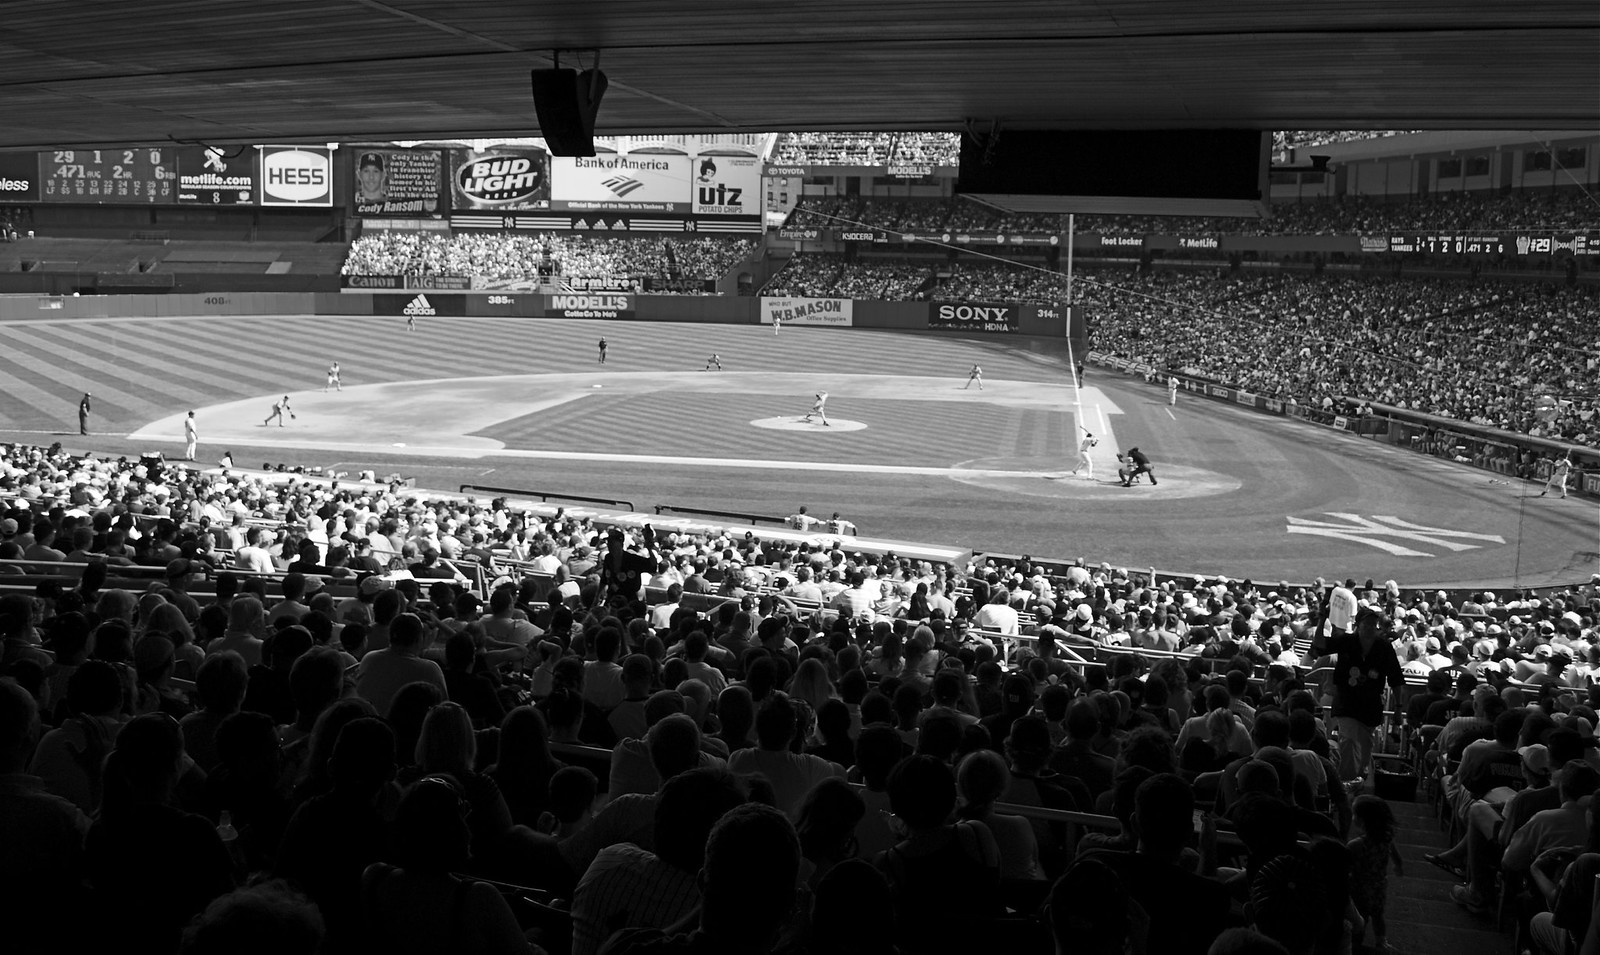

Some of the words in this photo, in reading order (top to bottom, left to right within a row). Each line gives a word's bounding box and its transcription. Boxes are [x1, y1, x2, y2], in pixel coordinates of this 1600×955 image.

[54, 150, 74, 163] 29
[94, 150, 102, 164] 1
[123, 150, 134, 164] 2
[150, 151, 160, 164] 0
[575, 156, 605, 168] Bank
[606, 157, 619, 168] of
[620, 158, 669, 170] America
[53, 164, 86, 178] .471
[112, 165, 122, 179] 2
[155, 166, 165, 180] 6
[472, 159, 530, 178] BUD
[888, 166, 932, 175] MODELL'S
[180, 174, 252, 185] metlife.com
[269, 168, 324, 185] HESS
[464, 172, 538, 192] LIGHT
[0, 178, 29, 191] less
[213, 192, 220, 204] 8
[842, 232, 873, 240] KYOCERA
[1101, 236, 1117, 246] Foot
[1118, 236, 1142, 246] Locker
[1187, 238, 1218, 248] MetLife
[1442, 242, 1448, 253] 2
[1456, 242, 1462, 253] 0
[1530, 239, 1550, 252] #29
[348, 276, 395, 287] Canon
[412, 278, 433, 288] AIG
[651, 280, 705, 289] SHARP
[552, 296, 628, 310] MODELL'S
[940, 305, 1008, 321] SONY
[984, 322, 1009, 332] HDNA
